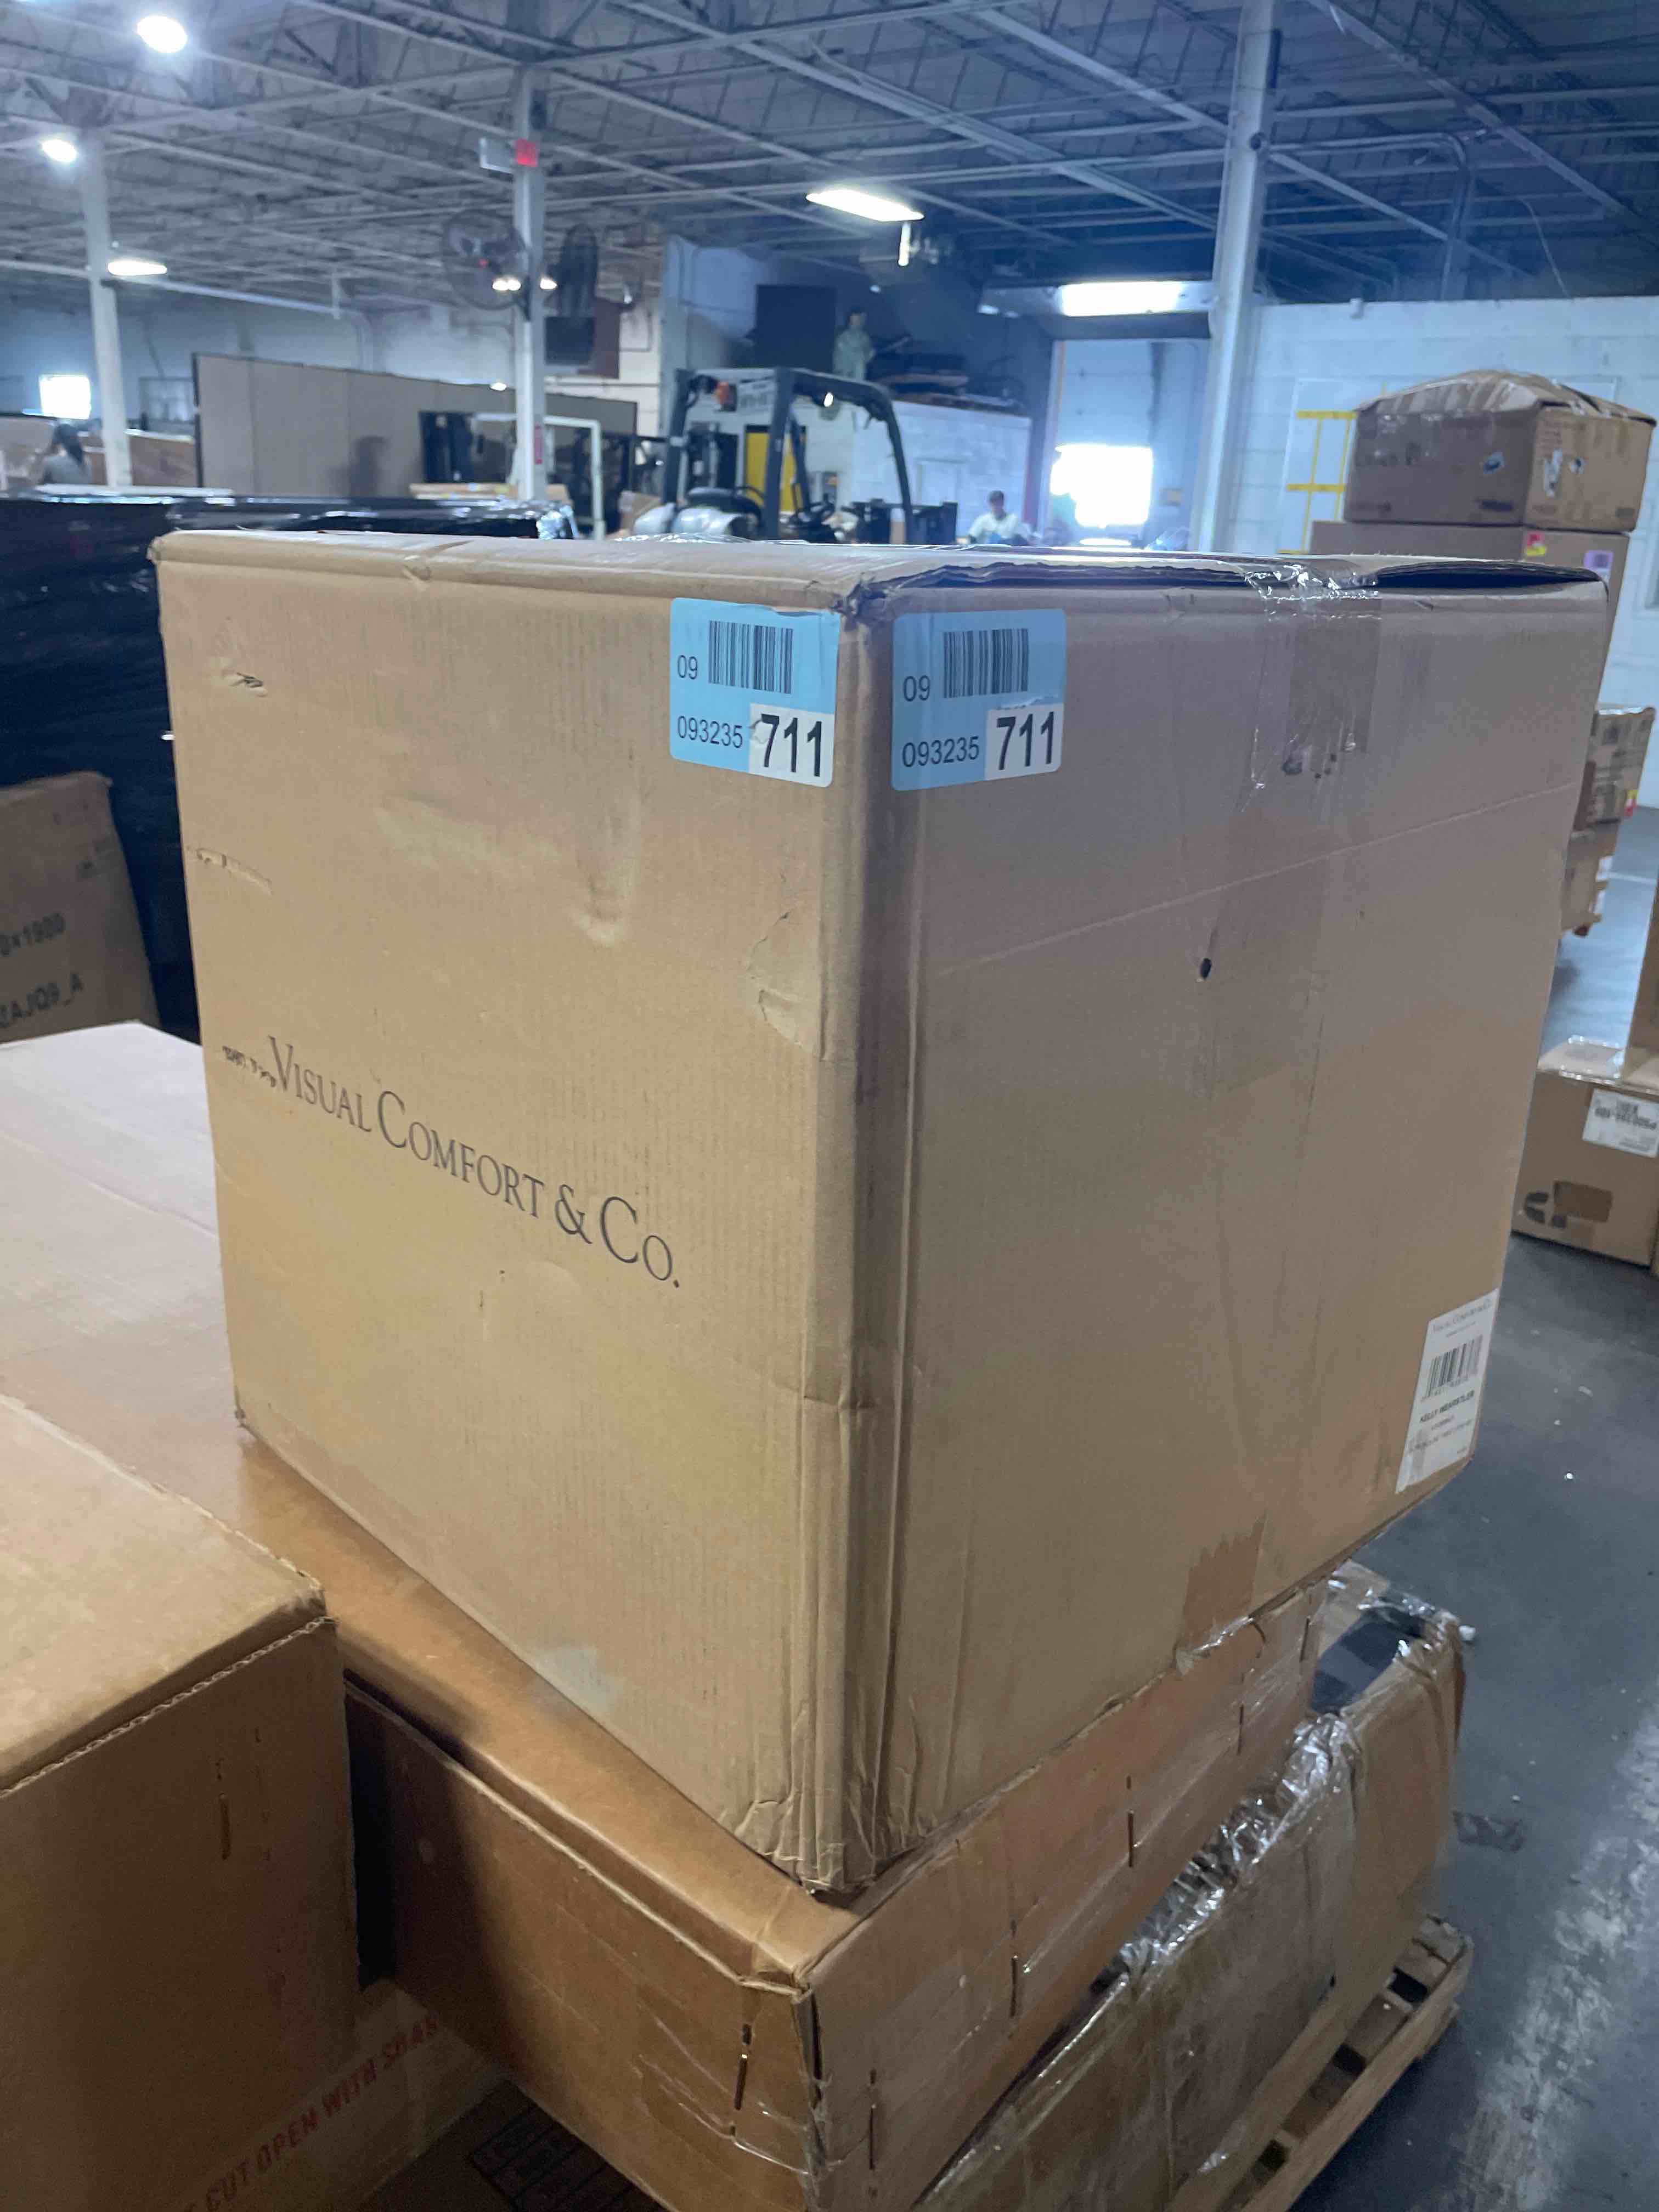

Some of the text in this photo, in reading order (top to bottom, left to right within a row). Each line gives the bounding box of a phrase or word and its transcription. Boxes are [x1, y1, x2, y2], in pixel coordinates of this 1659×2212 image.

[678, 655, 698, 680] 09
[903, 675, 931, 702] 09
[677, 715, 743, 748] 093235
[760, 714, 822, 777] 711
[902, 736, 980, 768] 093235
[997, 712, 1055, 770] 711
[268, 1035, 372, 1132] VISUAL
[377, 1091, 546, 1217] COMFORT
[555, 1184, 592, 1244] &
[206, 2159, 252, 2211] CUT
[257, 2108, 319, 2173] OPEN
[321, 2058, 378, 2118] WITH
